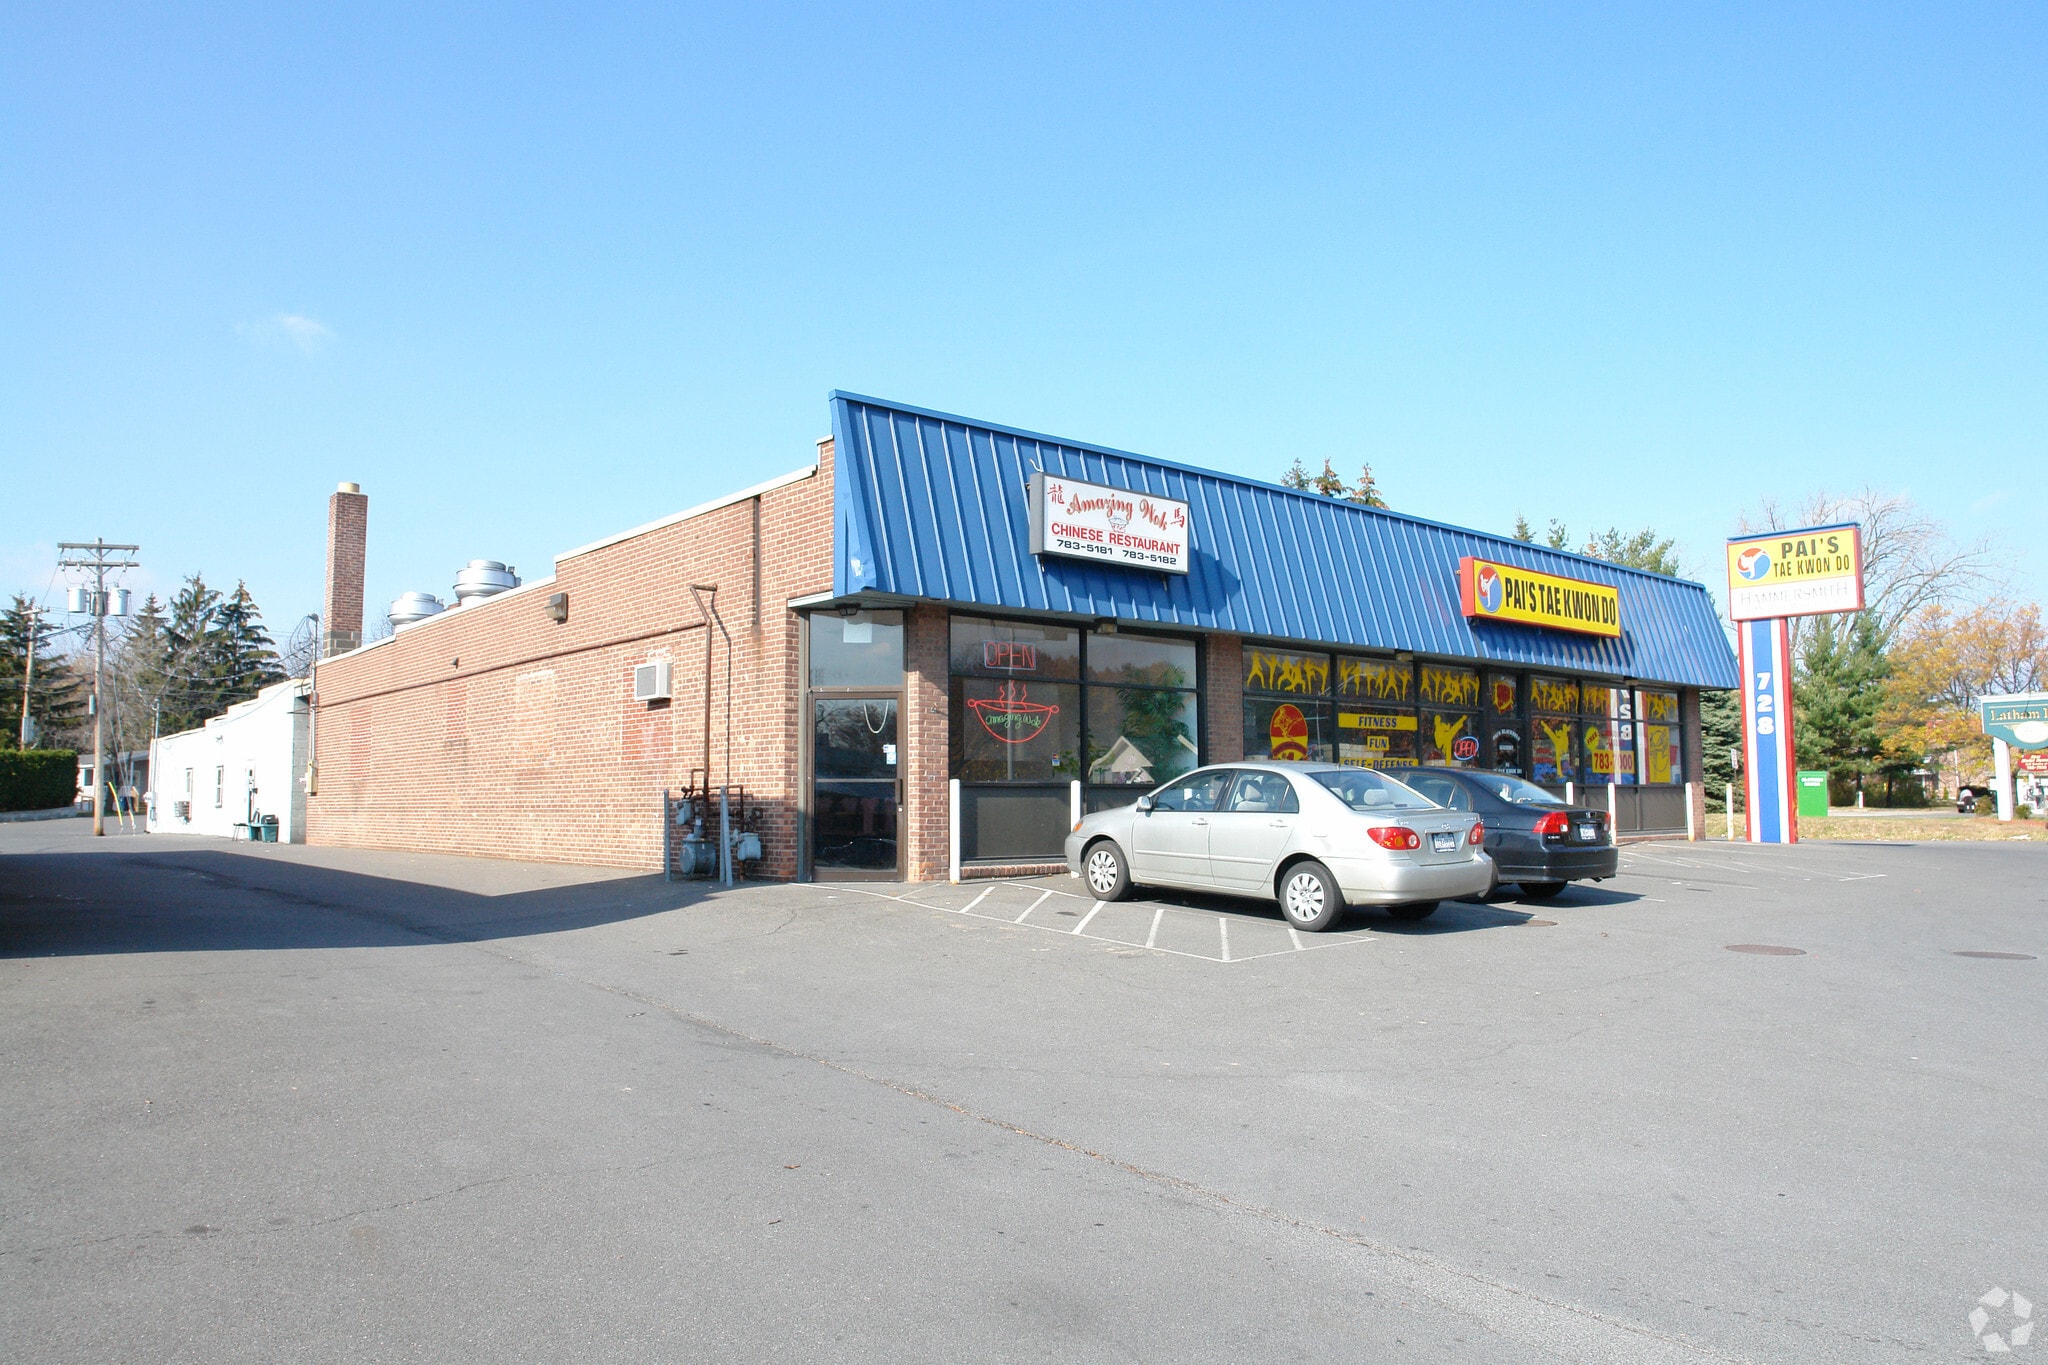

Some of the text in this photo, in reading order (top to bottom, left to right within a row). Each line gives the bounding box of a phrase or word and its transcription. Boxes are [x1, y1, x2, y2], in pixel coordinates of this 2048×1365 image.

[1066, 493, 1168, 531] Amazing Wok
[1051, 522, 1181, 555] CHINESE RESTAURANT
[1781, 536, 1839, 559] PAI'S
[1056, 539, 1177, 565] 783-5181 783-5182
[1774, 554, 1850, 577] TAE KWON DO
[1504, 577, 1616, 626] PAI'S TAE KWON DO
[985, 641, 1035, 669] OPEN
[1756, 672, 1775, 735] 728
[1990, 707, 2040, 720] Latham
[1358, 716, 1397, 728] FITNESS
[1369, 738, 1387, 749] FUN
[1455, 740, 1476, 756] OPEN
[1593, 753, 1633, 770] 783-000
